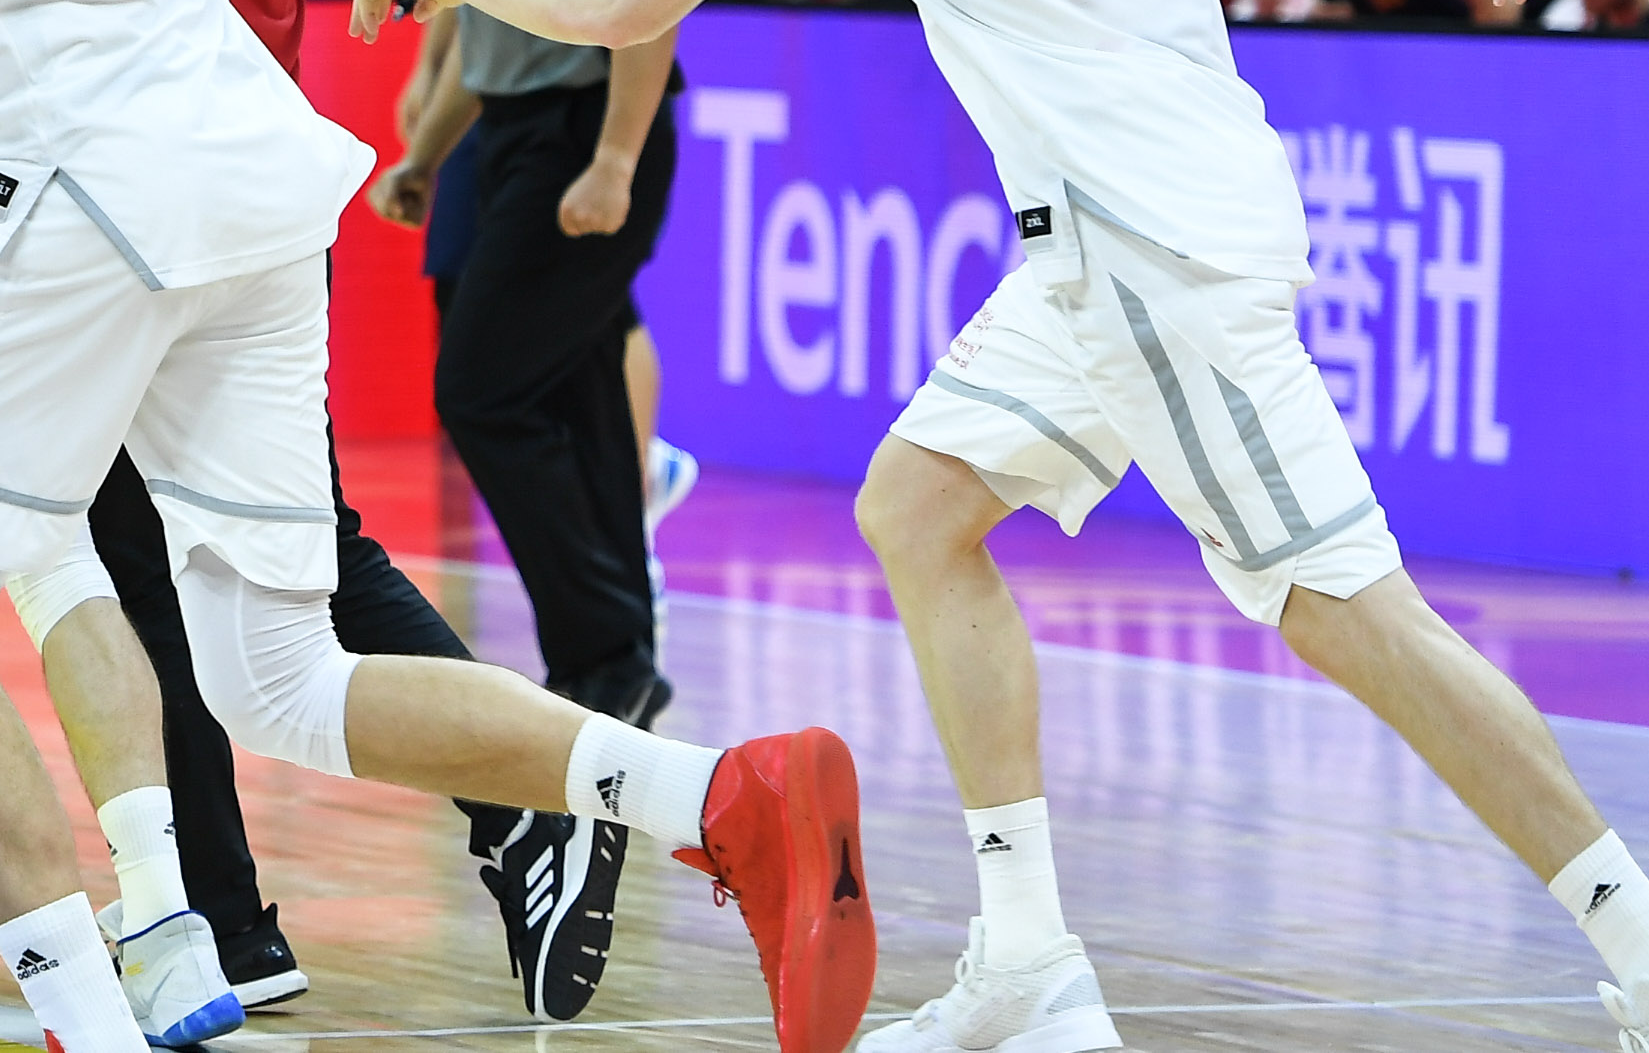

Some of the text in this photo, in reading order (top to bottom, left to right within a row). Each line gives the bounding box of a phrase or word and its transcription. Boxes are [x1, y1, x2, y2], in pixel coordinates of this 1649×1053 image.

[689, 85, 1028, 402] Tenc
[611, 769, 627, 817] adidas
[16, 959, 60, 980] adidas
